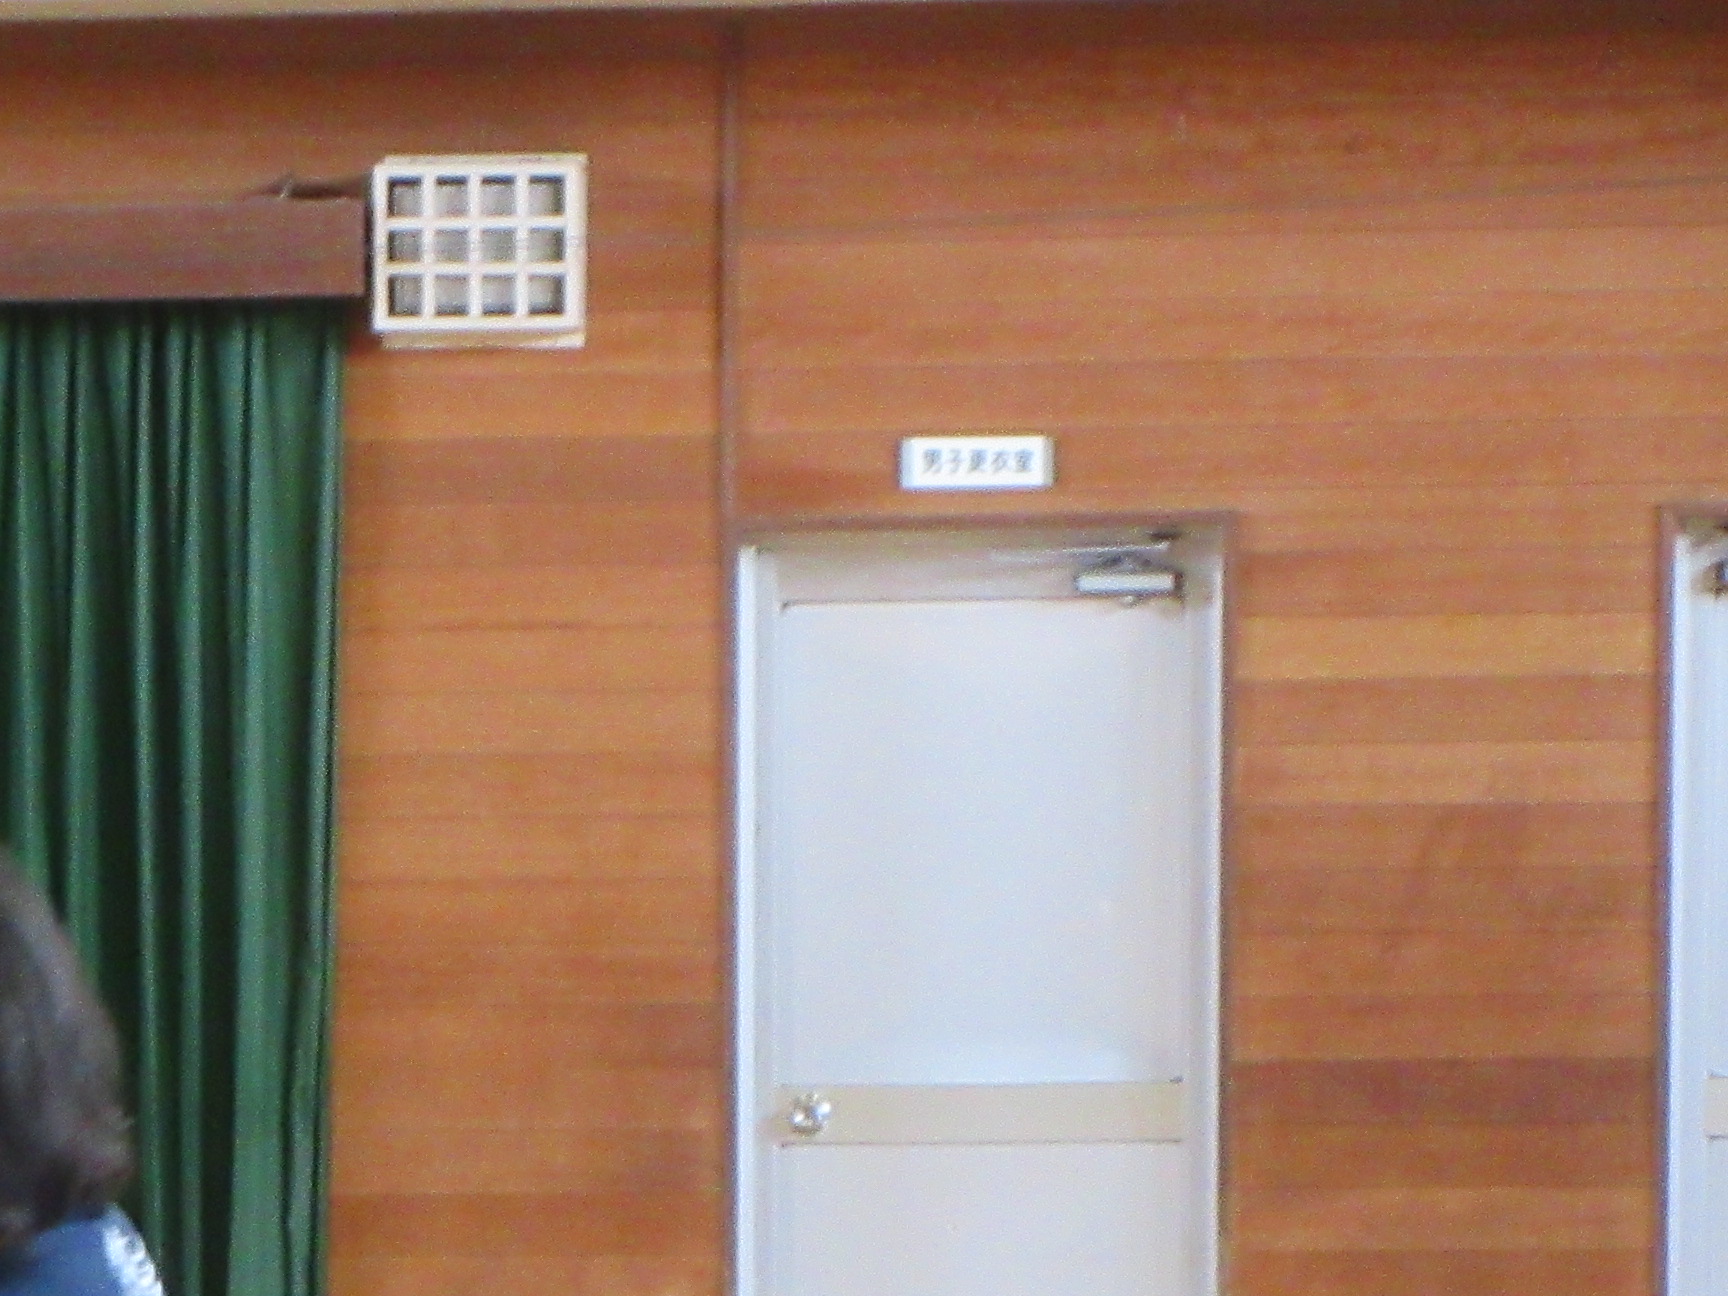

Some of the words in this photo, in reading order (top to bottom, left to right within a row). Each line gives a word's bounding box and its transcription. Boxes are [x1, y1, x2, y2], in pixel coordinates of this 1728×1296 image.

[923, 448, 1034, 474] 男子更衣室
